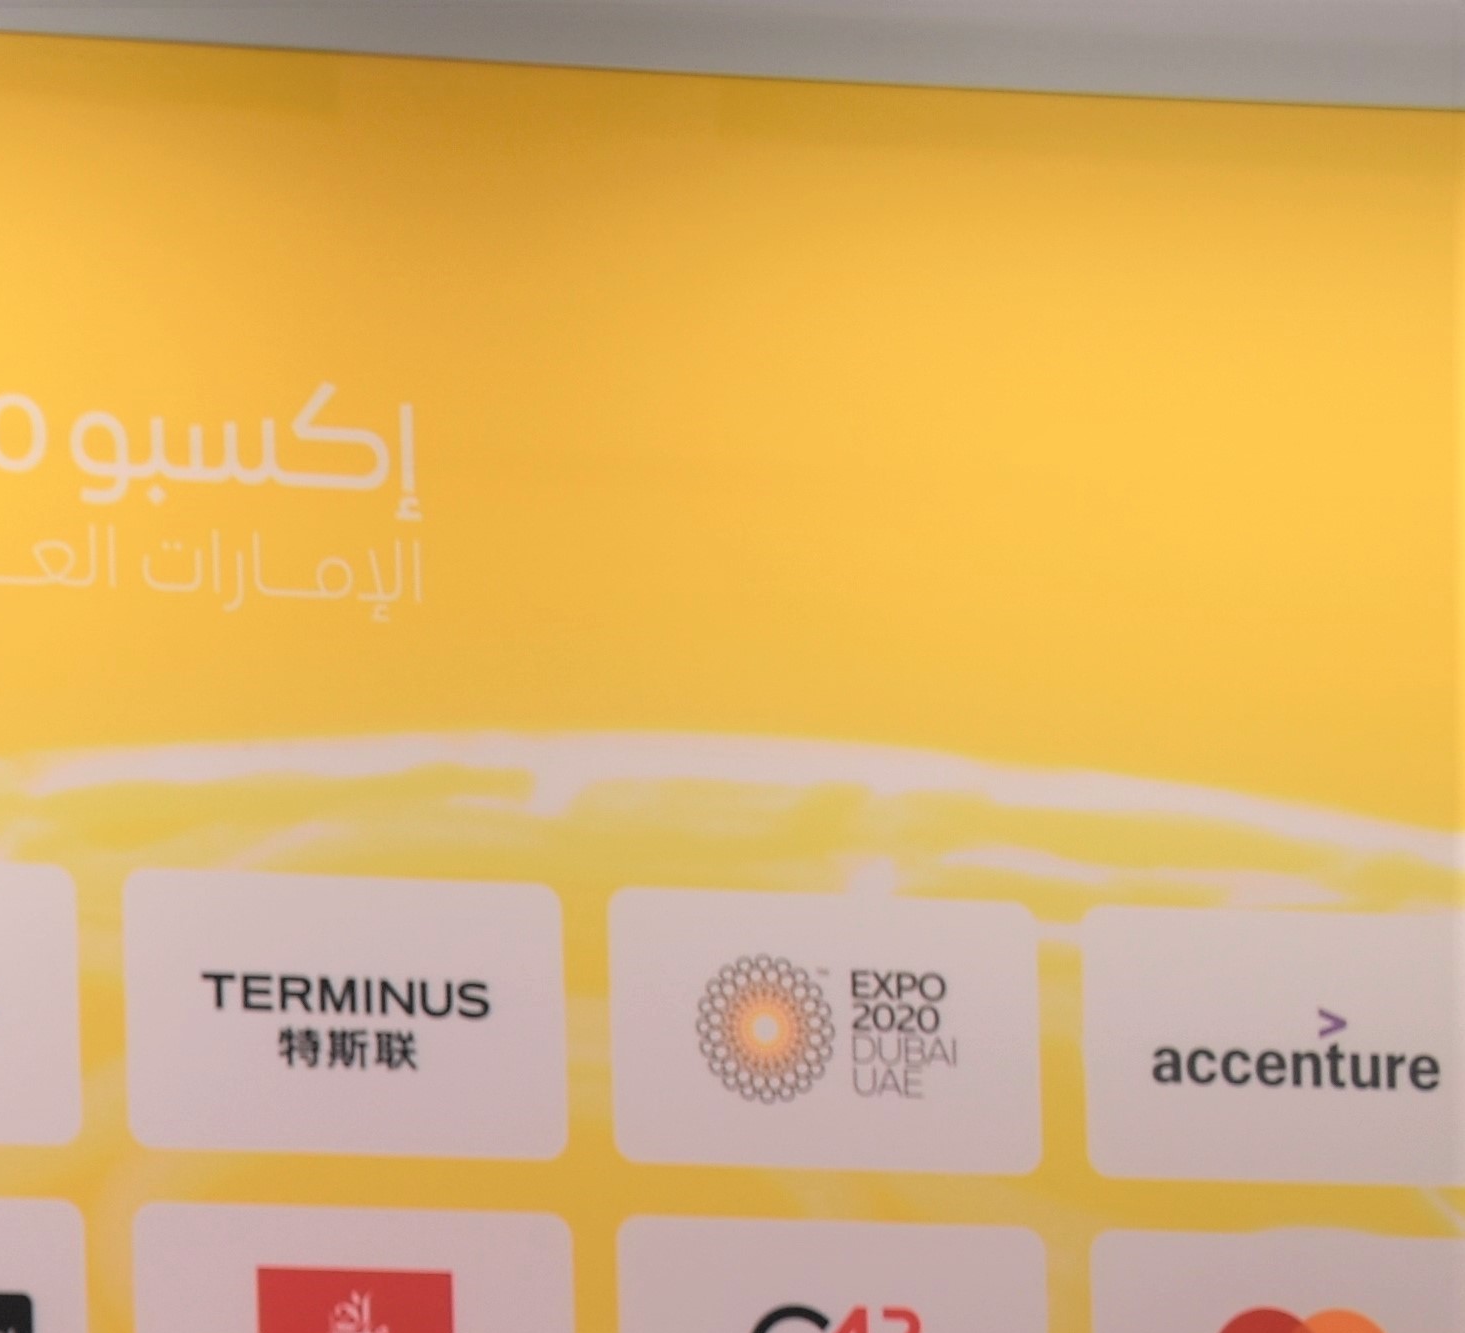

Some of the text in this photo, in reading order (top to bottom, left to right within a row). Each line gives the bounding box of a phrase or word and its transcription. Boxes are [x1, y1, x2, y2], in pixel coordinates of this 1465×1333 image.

[70, 382, 421, 520] إكسبو
[202, 973, 490, 1019] TERMINUS
[851, 971, 946, 1002] EXPO
[853, 1003, 939, 1033] 2020
[279, 1028, 416, 1069] 特斯联
[852, 1036, 956, 1067] DUBAI
[853, 1068, 921, 1098] UAE
[1153, 1044, 1440, 1091] accenture
